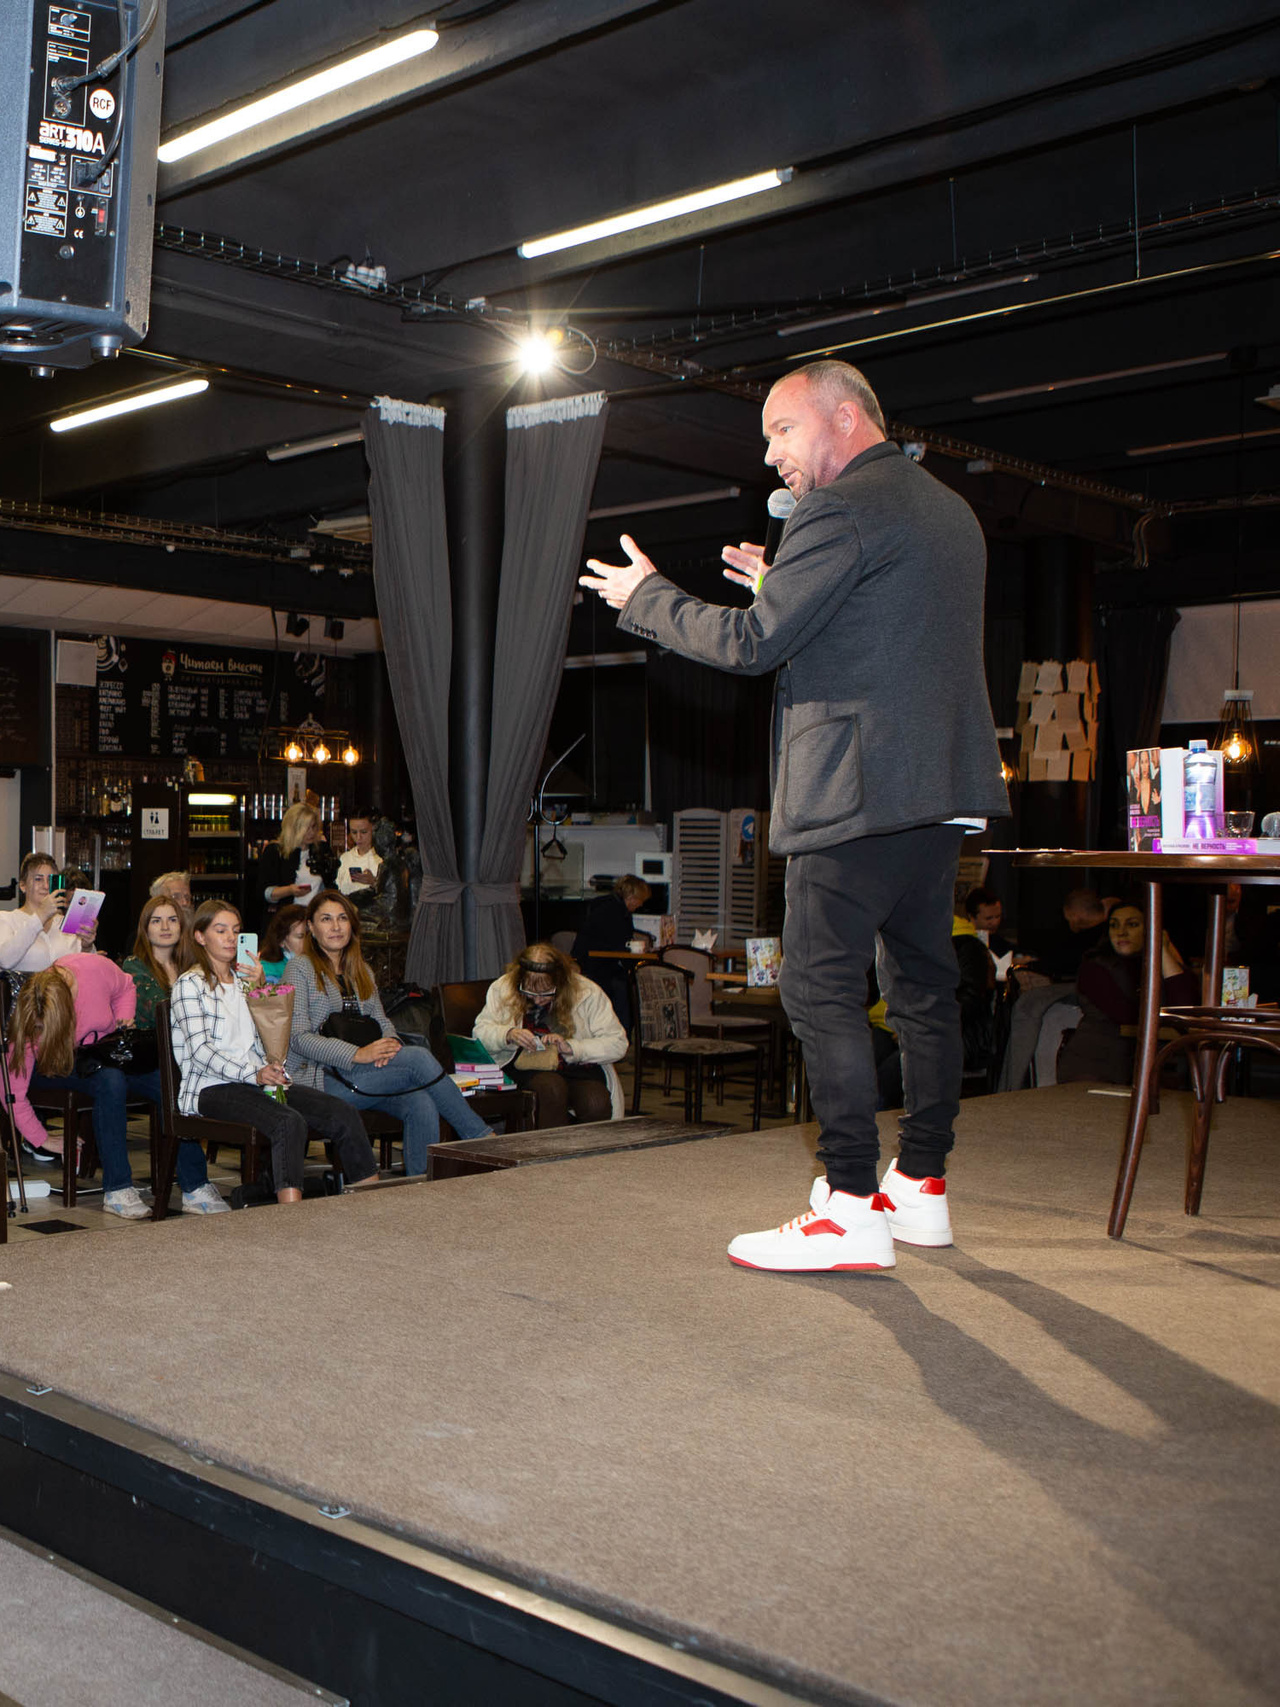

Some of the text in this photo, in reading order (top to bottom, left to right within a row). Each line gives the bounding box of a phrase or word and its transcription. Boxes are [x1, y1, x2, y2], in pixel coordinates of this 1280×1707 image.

[92, 97, 112, 111] RCF
[65, 127, 106, 155] 310A
[180, 652, 264, 675] Читаем вместе
